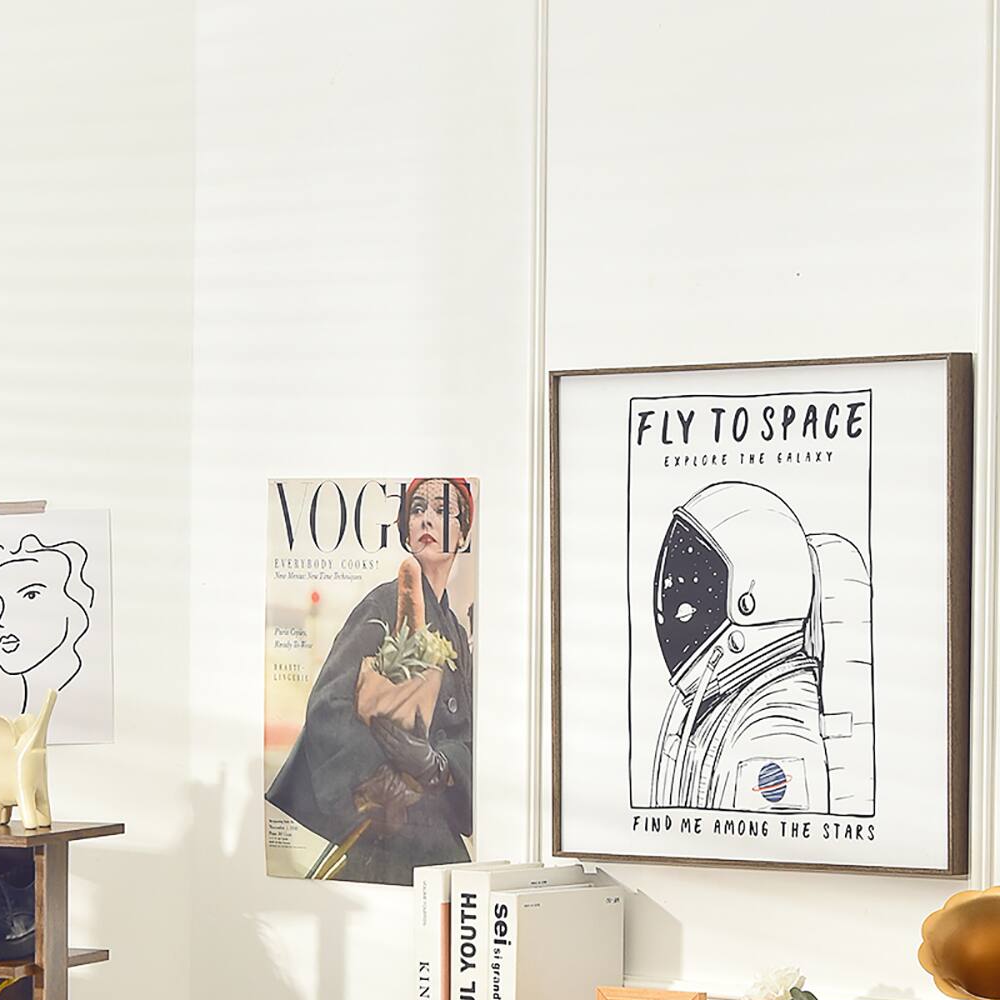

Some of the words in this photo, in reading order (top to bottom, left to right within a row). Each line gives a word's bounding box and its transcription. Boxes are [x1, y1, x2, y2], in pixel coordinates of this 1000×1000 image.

[637, 409, 695, 446] FLY
[711, 406, 749, 443] TO
[761, 402, 866, 441] SPACE
[664, 453, 728, 467] EXPLORE
[740, 452, 766, 465] THE
[777, 451, 833, 464] GALAXY
[633, 815, 672, 833] FIND
[680, 817, 702, 834] ME
[713, 819, 769, 837] AMONG
[780, 821, 811, 839] THE
[823, 822, 876, 841] STARS
[460, 892, 478, 973] YOUTH
[493, 903, 512, 946] sei
